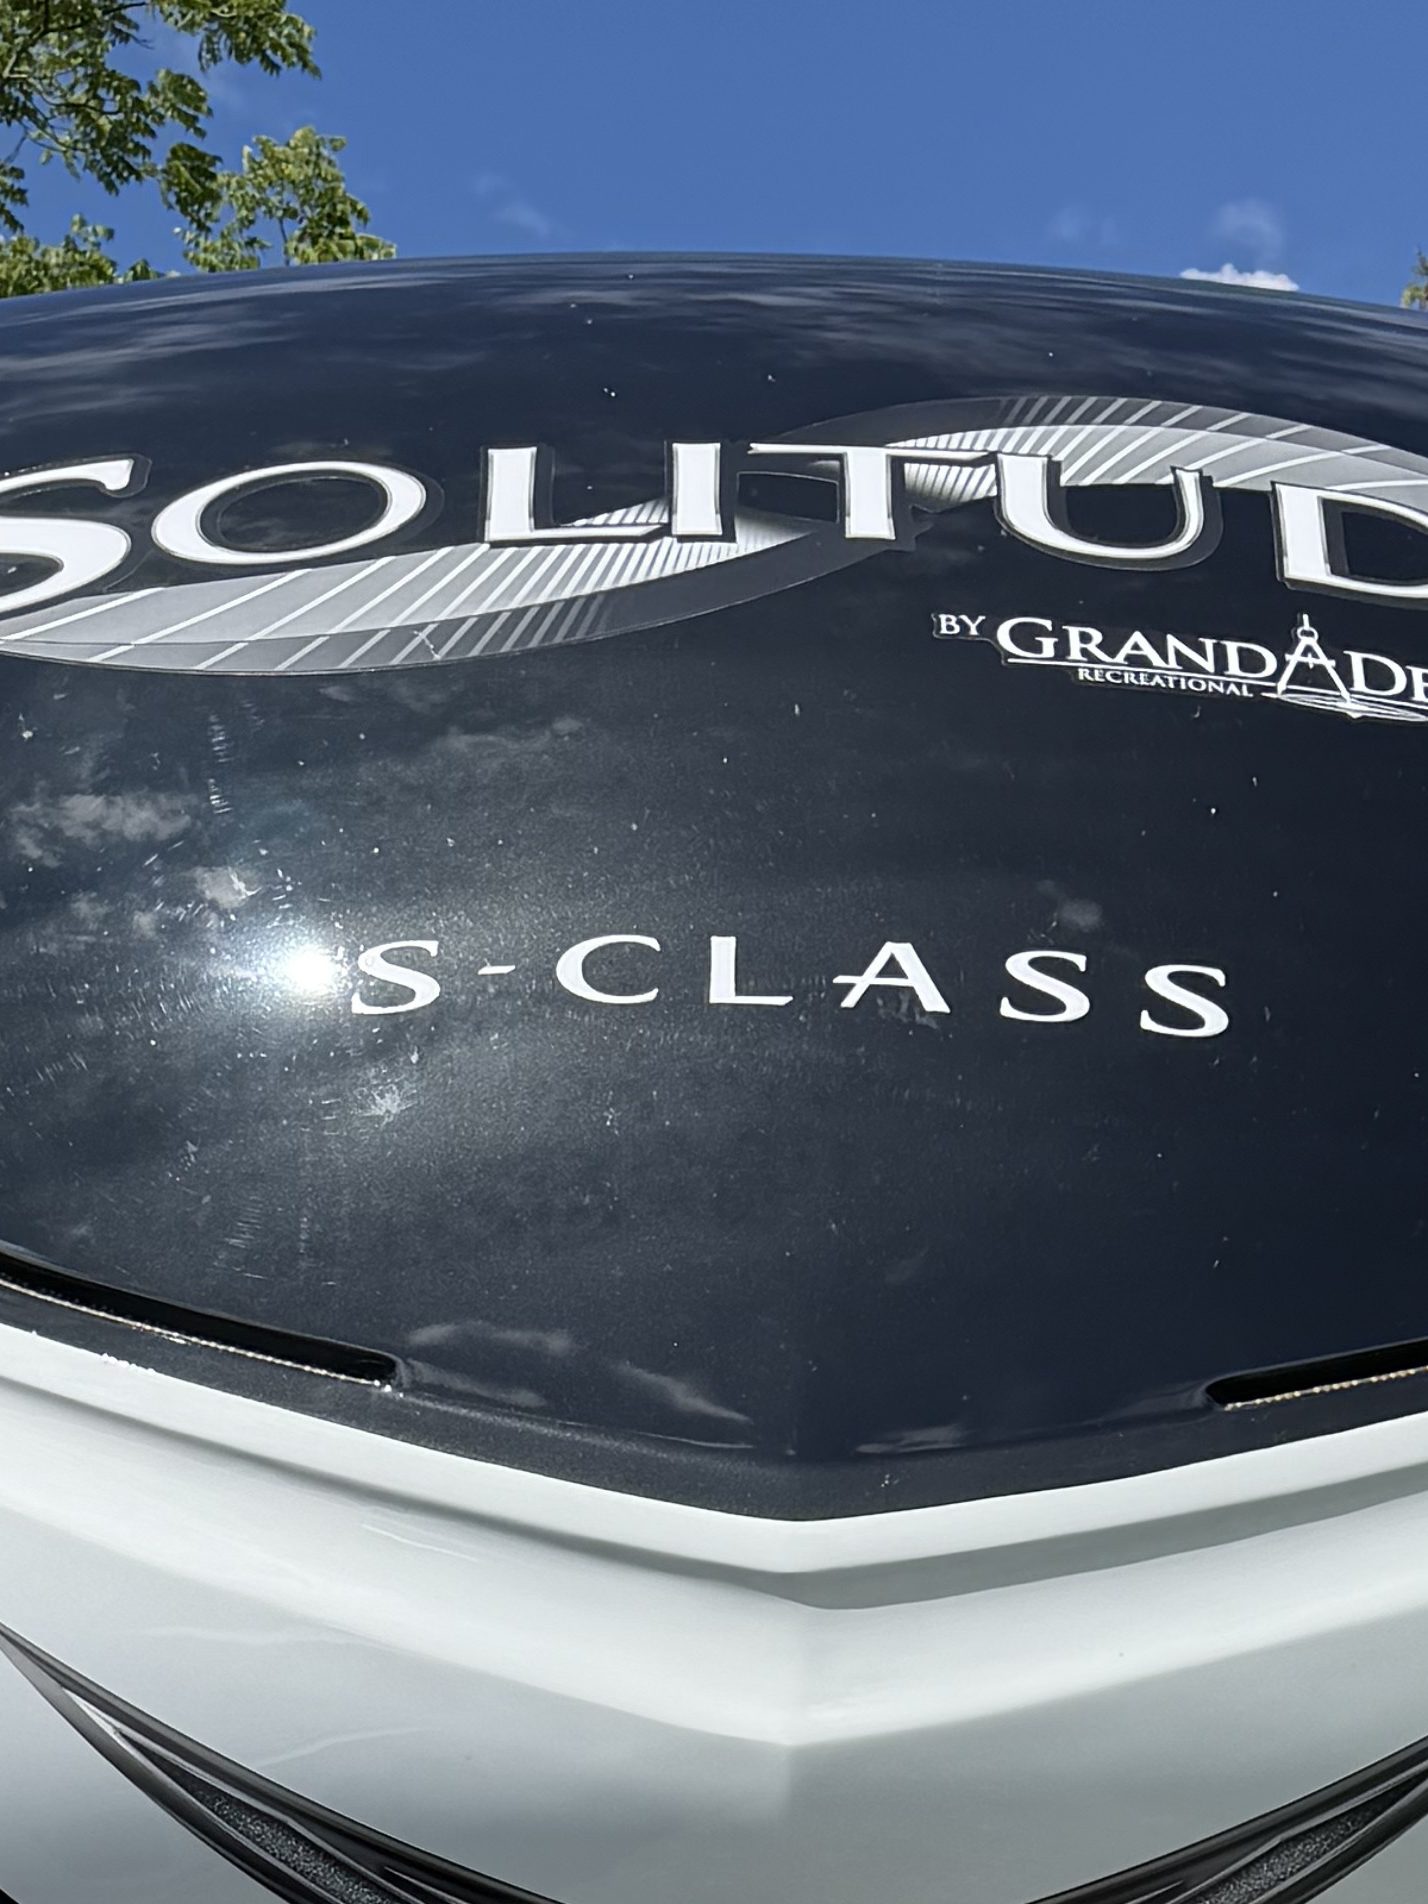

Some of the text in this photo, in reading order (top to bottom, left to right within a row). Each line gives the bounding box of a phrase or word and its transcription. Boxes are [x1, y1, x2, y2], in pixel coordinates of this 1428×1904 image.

[939, 613, 986, 636] BY
[996, 616, 1278, 679] GRAND
[1077, 667, 1254, 698] RECREATIONAL
[350, 934, 1230, 1039] S-CLASS
